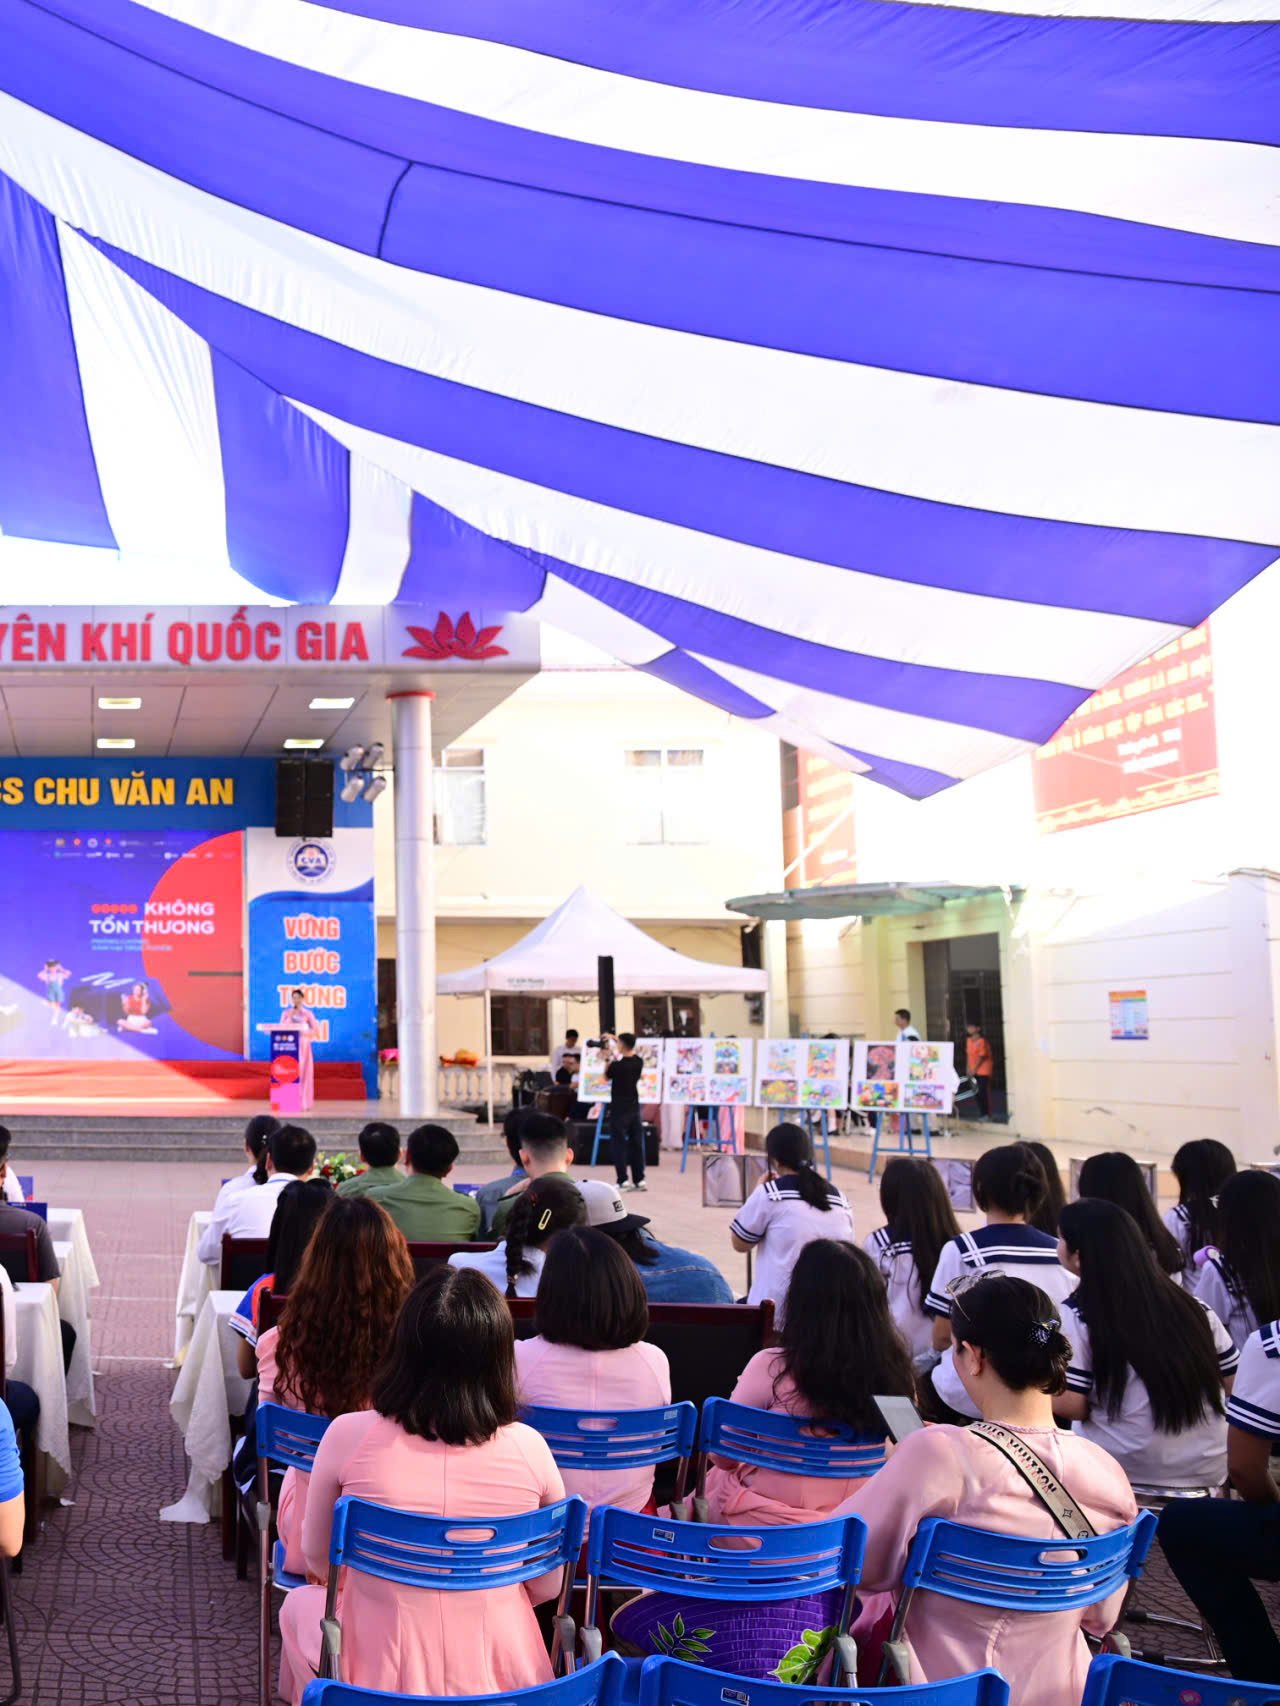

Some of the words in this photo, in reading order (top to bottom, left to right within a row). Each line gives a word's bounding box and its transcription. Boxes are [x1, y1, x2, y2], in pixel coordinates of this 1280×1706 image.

[81, 613, 155, 662] KHÍ
[167, 606, 281, 666] QUỐC
[295, 622, 369, 662] GIA
[34, 777, 100, 806] CHU
[110, 770, 175, 806] VĂN
[185, 777, 234, 806] AN
[144, 899, 216, 917] KHÔNG
[284, 913, 340, 940] VỮNG
[284, 947, 340, 975] BƯỚC
[277, 983, 347, 1009] TƠNG
[1006, 1438, 1058, 1494] VUITTON
